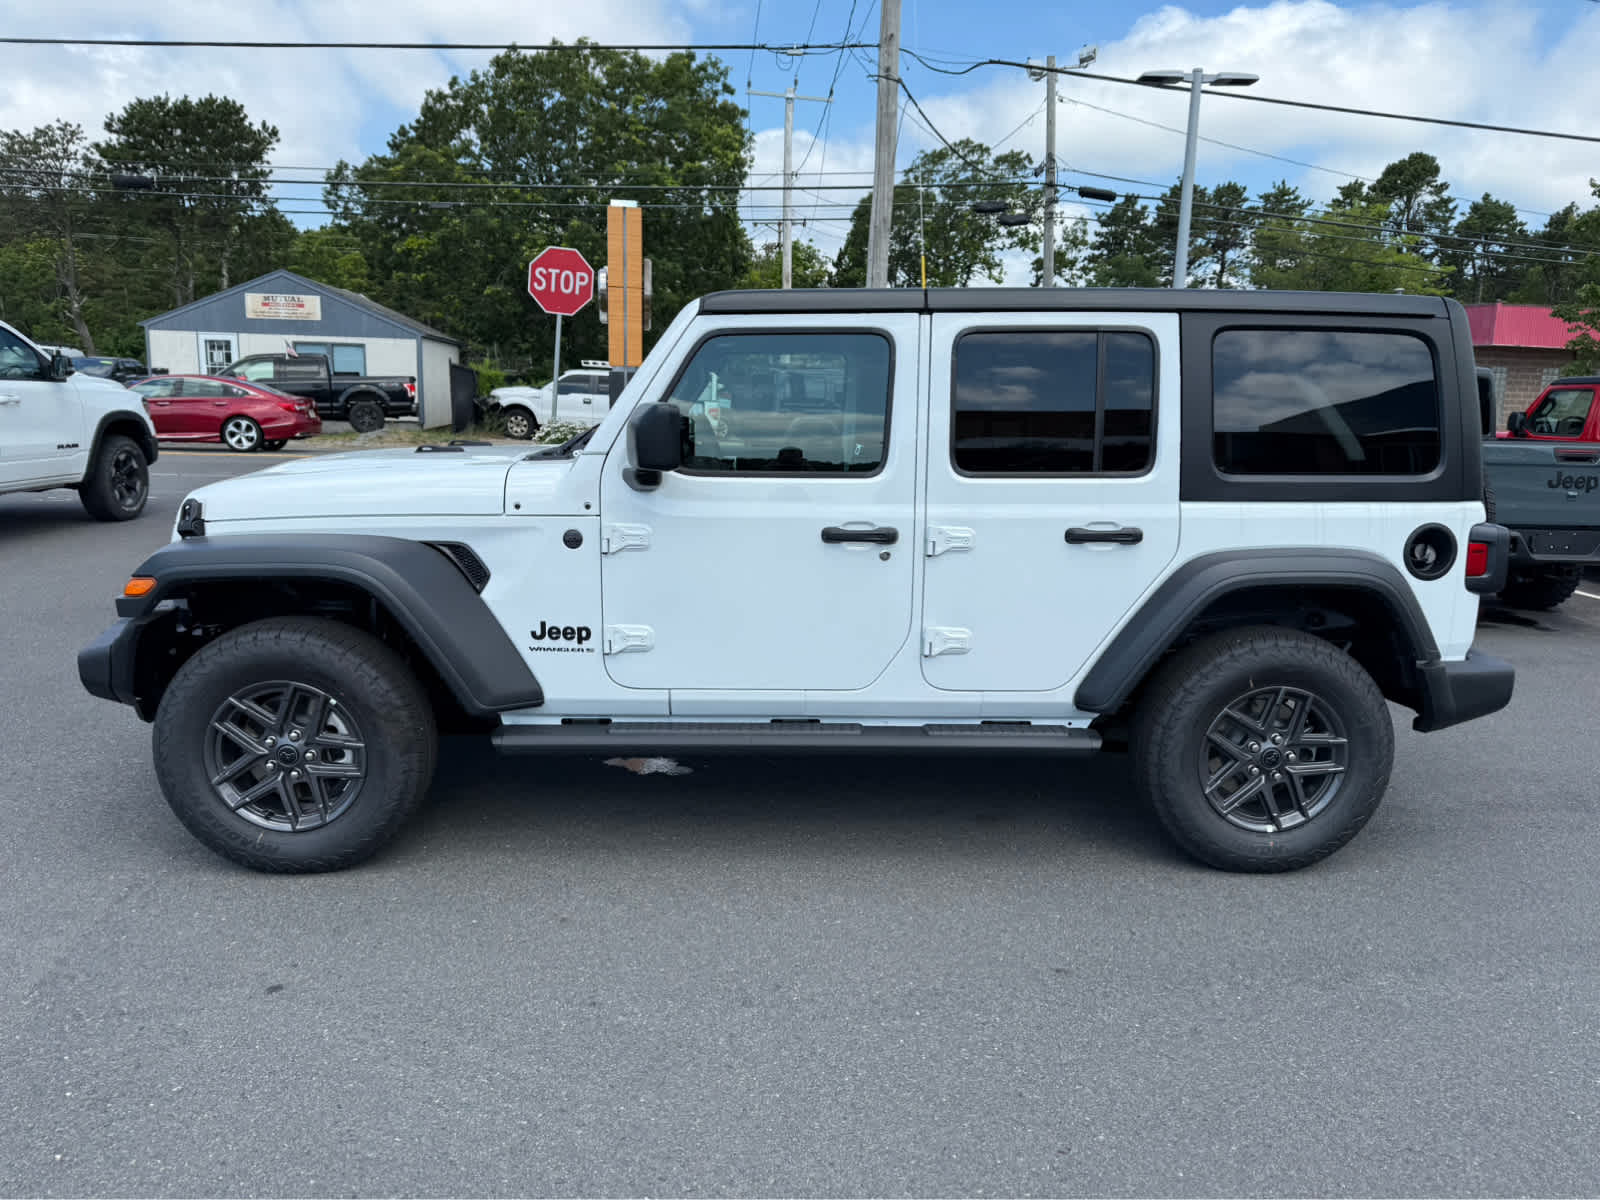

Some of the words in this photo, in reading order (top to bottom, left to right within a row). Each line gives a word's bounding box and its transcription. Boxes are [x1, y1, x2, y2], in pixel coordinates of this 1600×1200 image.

[534, 267, 589, 295] STOP
[1548, 471, 1598, 493] Jeep
[531, 621, 591, 644] Jeep
